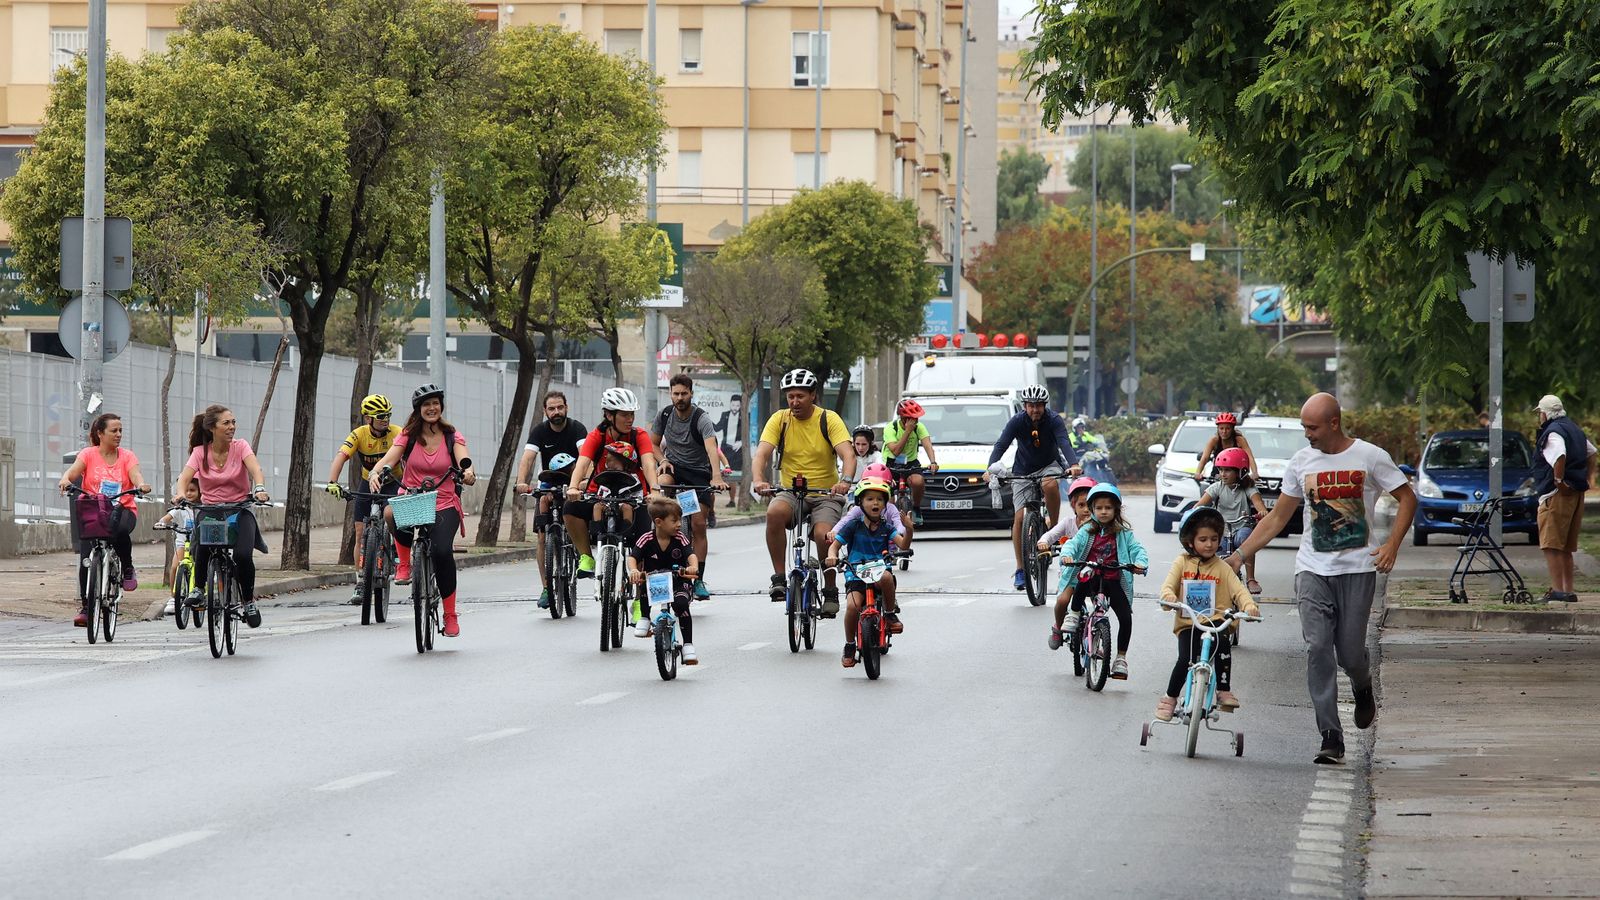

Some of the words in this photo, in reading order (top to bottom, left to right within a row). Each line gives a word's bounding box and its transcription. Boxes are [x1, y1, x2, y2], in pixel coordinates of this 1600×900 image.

[1317, 470, 1363, 486] KING
[1317, 486, 1362, 500] KONG
[936, 501, 955, 509] 8826
[957, 500, 972, 509] JPC
